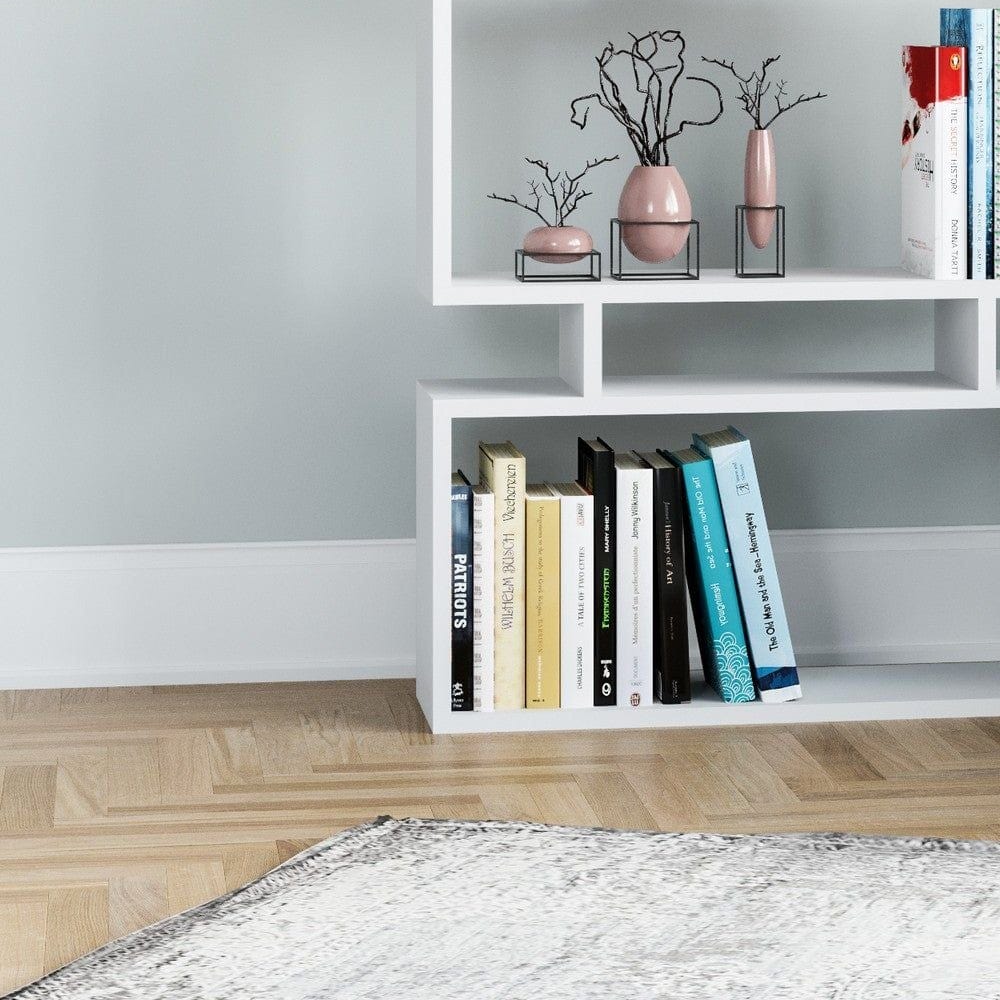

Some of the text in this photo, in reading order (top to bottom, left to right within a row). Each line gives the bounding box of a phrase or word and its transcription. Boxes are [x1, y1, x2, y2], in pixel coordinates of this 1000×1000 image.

[950, 109, 958, 195] THE SECRET HISTORY
[951, 220, 959, 276] DONNA TARTT
[631, 481, 641, 540] Jonny Wilkinson
[664, 524, 672, 554] History
[502, 532, 515, 574] BUSCH
[577, 546, 585, 571] CITIES
[666, 556, 674, 566] of
[577, 572, 585, 590] TWO
[666, 569, 674, 585] Art
[756, 574, 767, 588] the
[454, 553, 468, 630] PATRIOTS
[577, 592, 585, 601] OF
[759, 588, 769, 602] and
[502, 576, 514, 631] WILHELM
[577, 602, 585, 620] TALE
[761, 603, 773, 620] Man
[764, 620, 776, 636] Old
[767, 636, 779, 651] The
